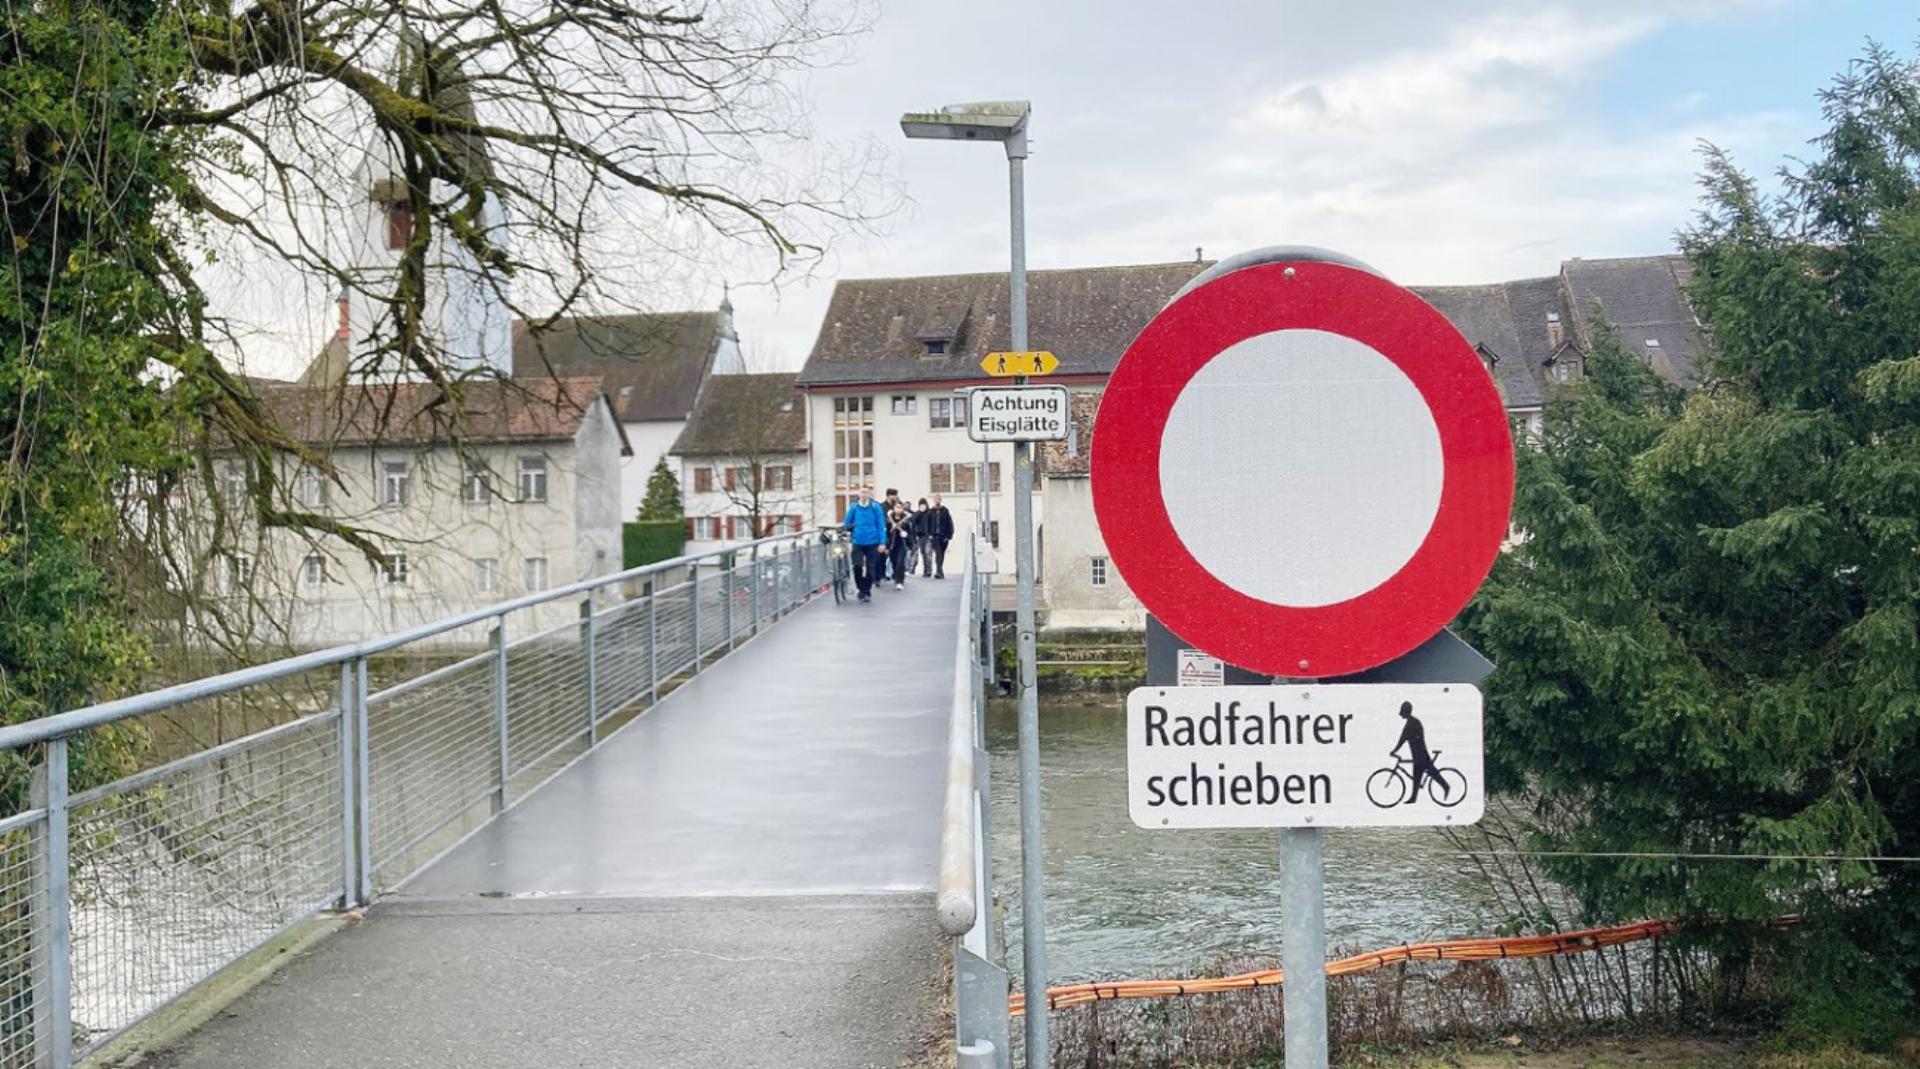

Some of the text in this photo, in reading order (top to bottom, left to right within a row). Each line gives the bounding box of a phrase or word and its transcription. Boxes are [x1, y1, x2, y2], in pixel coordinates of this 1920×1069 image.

[981, 396, 1058, 413] Achtung
[979, 416, 1060, 435] Eisglätte
[1145, 701, 1354, 746] Radfahrer
[1146, 761, 1332, 806] schieben
